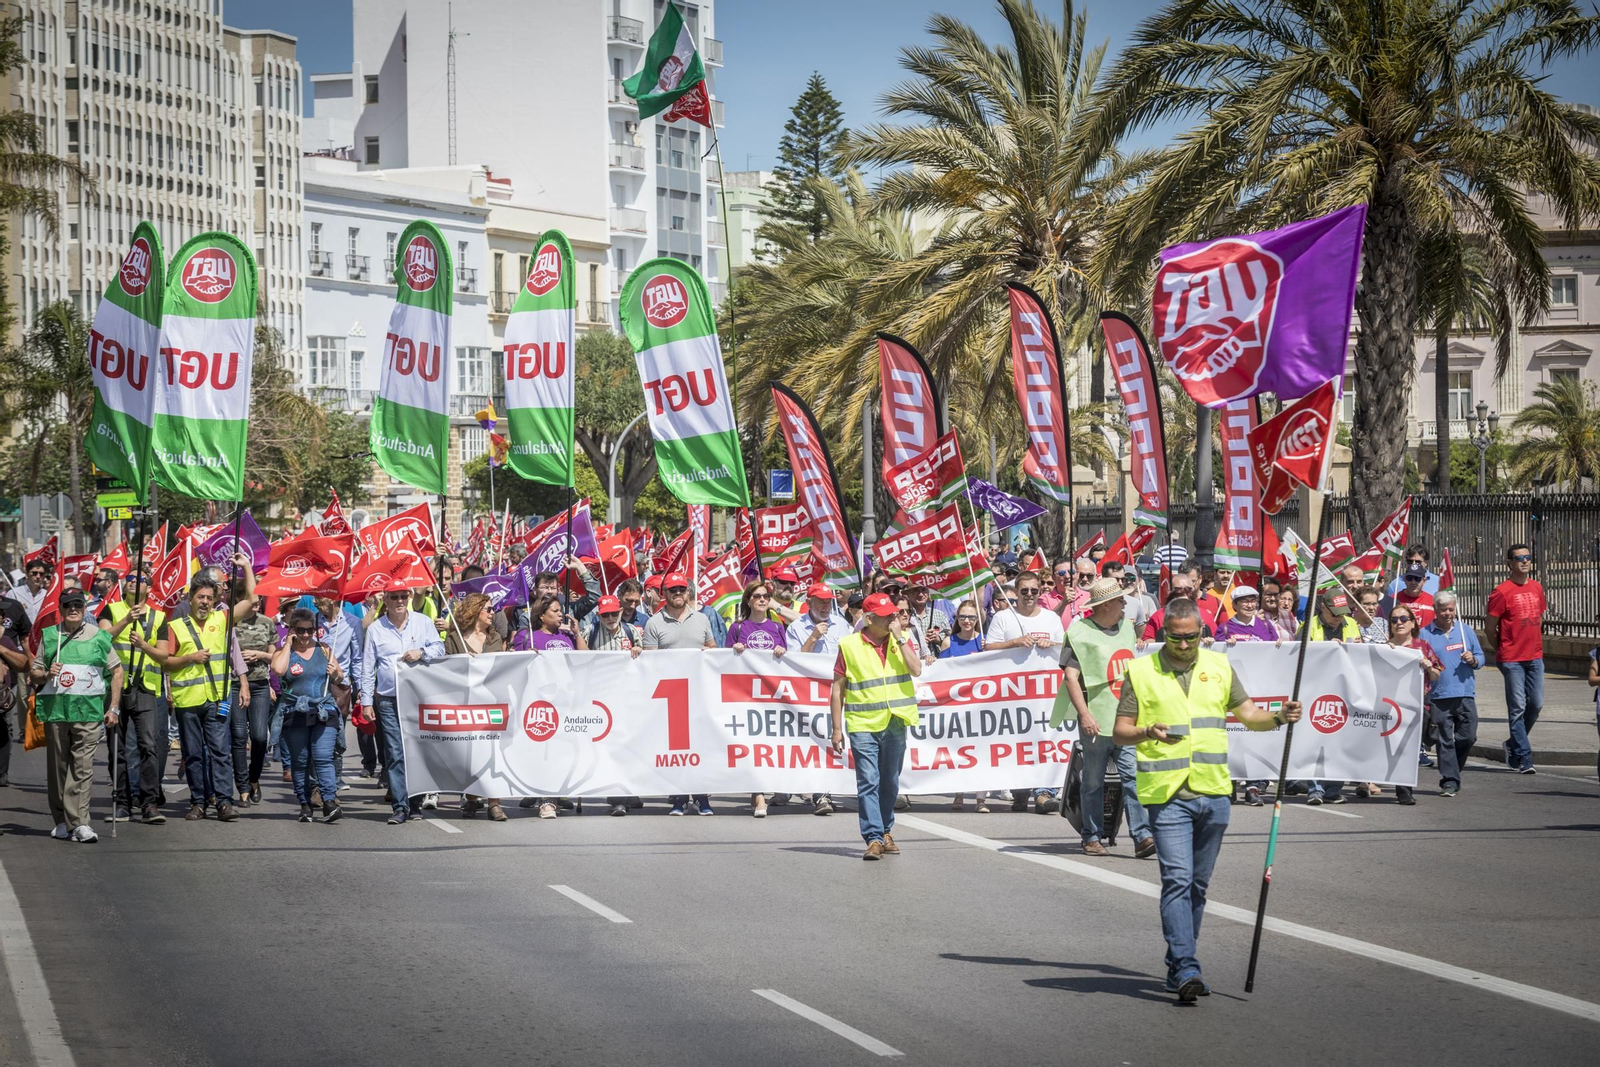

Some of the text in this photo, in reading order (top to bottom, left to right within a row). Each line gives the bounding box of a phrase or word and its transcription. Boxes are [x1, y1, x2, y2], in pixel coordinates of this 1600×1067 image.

[751, 677, 799, 701] LA
[950, 672, 1064, 702] CONTI
[423, 708, 489, 726] CCOO
[526, 706, 555, 724] UGT
[651, 678, 690, 751] 1
[1313, 700, 1344, 717] UGT
[563, 715, 604, 725] Andalucía
[724, 708, 833, 740] +DEREC
[910, 706, 1032, 741] GUALDAD
[442, 734, 477, 742] provincial
[655, 753, 700, 768] MAYO
[910, 745, 978, 770] LAS
